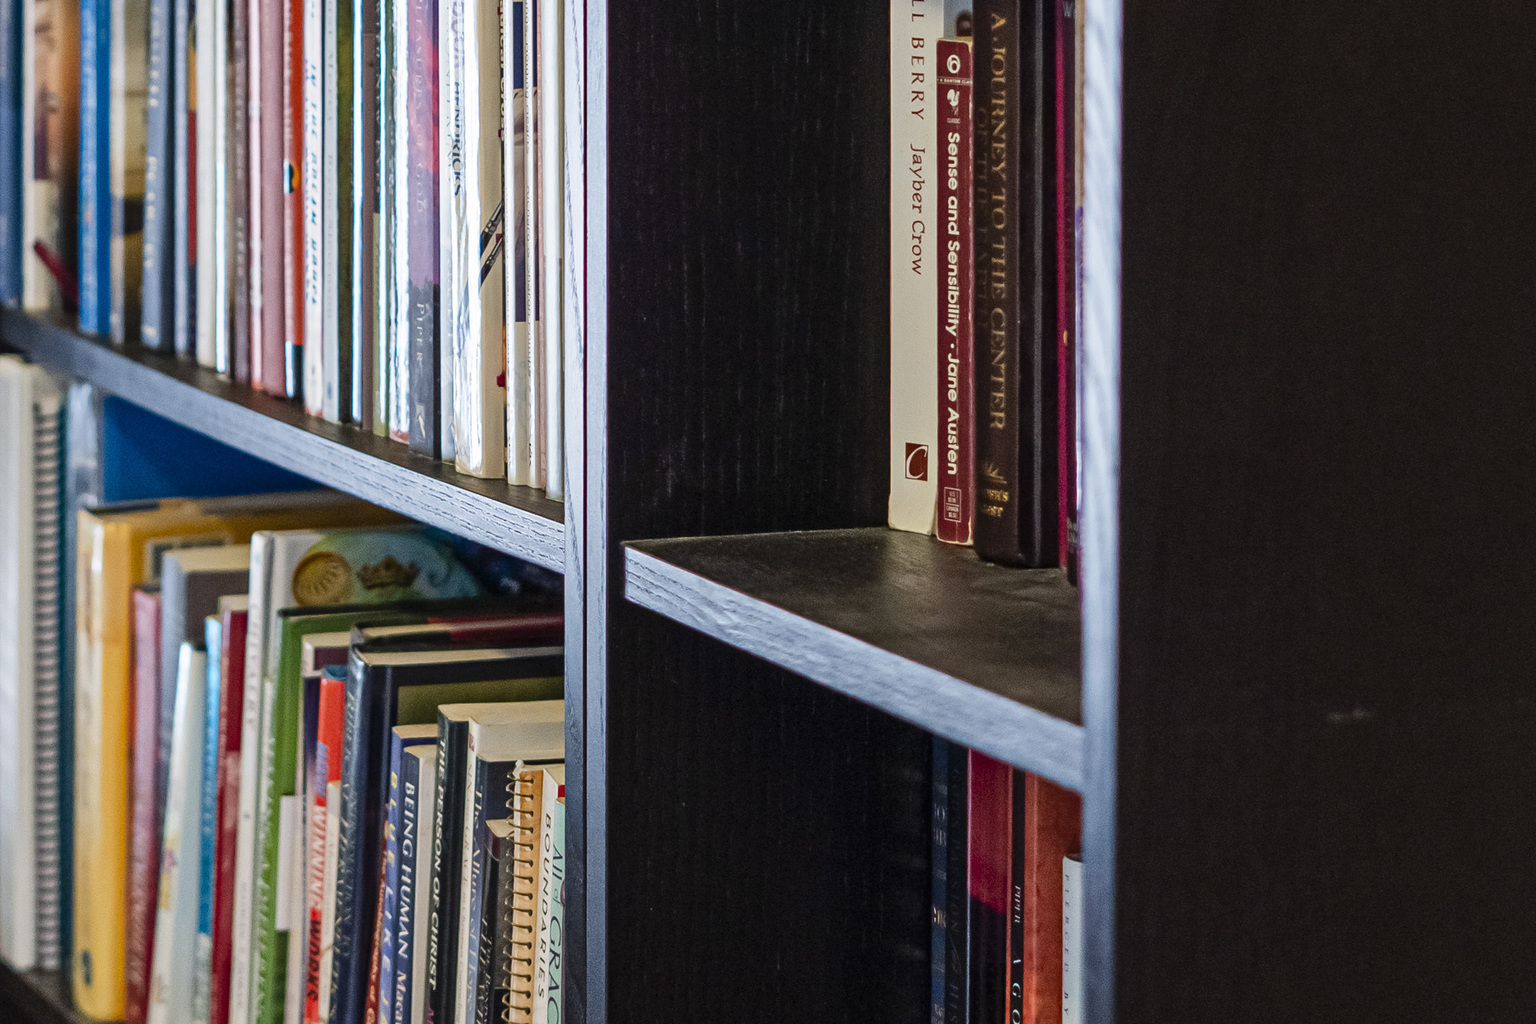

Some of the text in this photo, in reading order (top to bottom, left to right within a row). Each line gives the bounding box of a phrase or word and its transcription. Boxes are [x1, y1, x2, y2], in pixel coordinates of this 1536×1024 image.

[910, 36, 926, 121] BERRY
[909, 143, 927, 214] Jayber
[947, 131, 961, 190] Sense
[911, 219, 926, 276] Crow
[947, 196, 960, 236] and
[990, 11, 1007, 430] A JOURNEY TO THE CENTER
[944, 239, 961, 337] Sensibility
[946, 352, 960, 402] Jane
[946, 406, 960, 475] Austen
[386, 770, 398, 868] BLUE
[401, 781, 415, 858] BEING
[428, 738, 446, 990] THE PERSON OF CHRIST
[466, 784, 484, 1013] The Allure of Hope
[552, 844, 564, 880] All
[382, 885, 394, 974] LIKE
[397, 863, 413, 959] HUMAN
[537, 813, 552, 999] BOUNDARIES
[1013, 885, 1023, 924] PIPER
[546, 915, 562, 1024] GRAC
[1011, 982, 1022, 1024] GO
